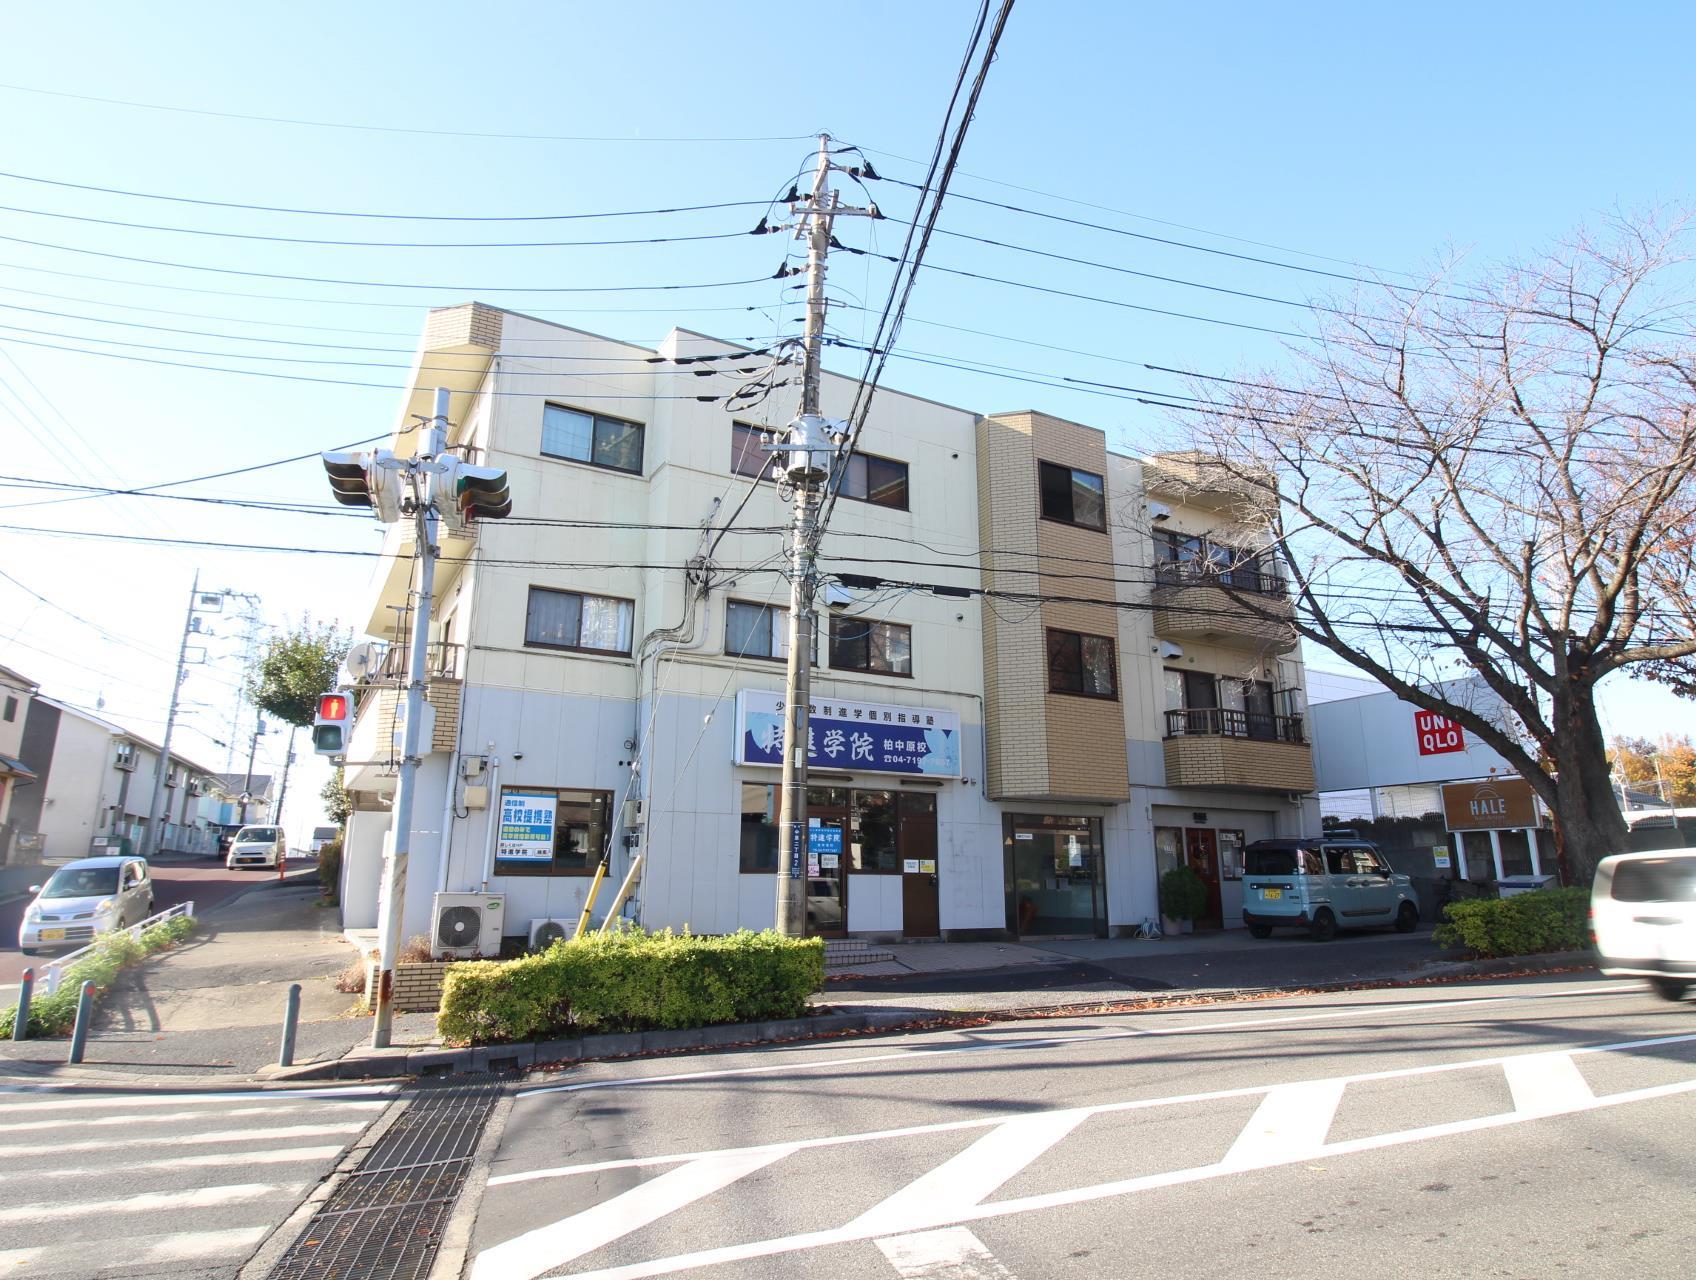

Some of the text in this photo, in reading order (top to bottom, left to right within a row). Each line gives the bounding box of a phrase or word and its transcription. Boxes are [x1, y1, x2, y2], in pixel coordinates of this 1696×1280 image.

[776, 701, 934, 725] 少数制進学個別指導塾
[884, 739, 927, 752] 柏中原校
[1424, 731, 1458, 751] QLO
[1470, 799, 1506, 815] HALE
